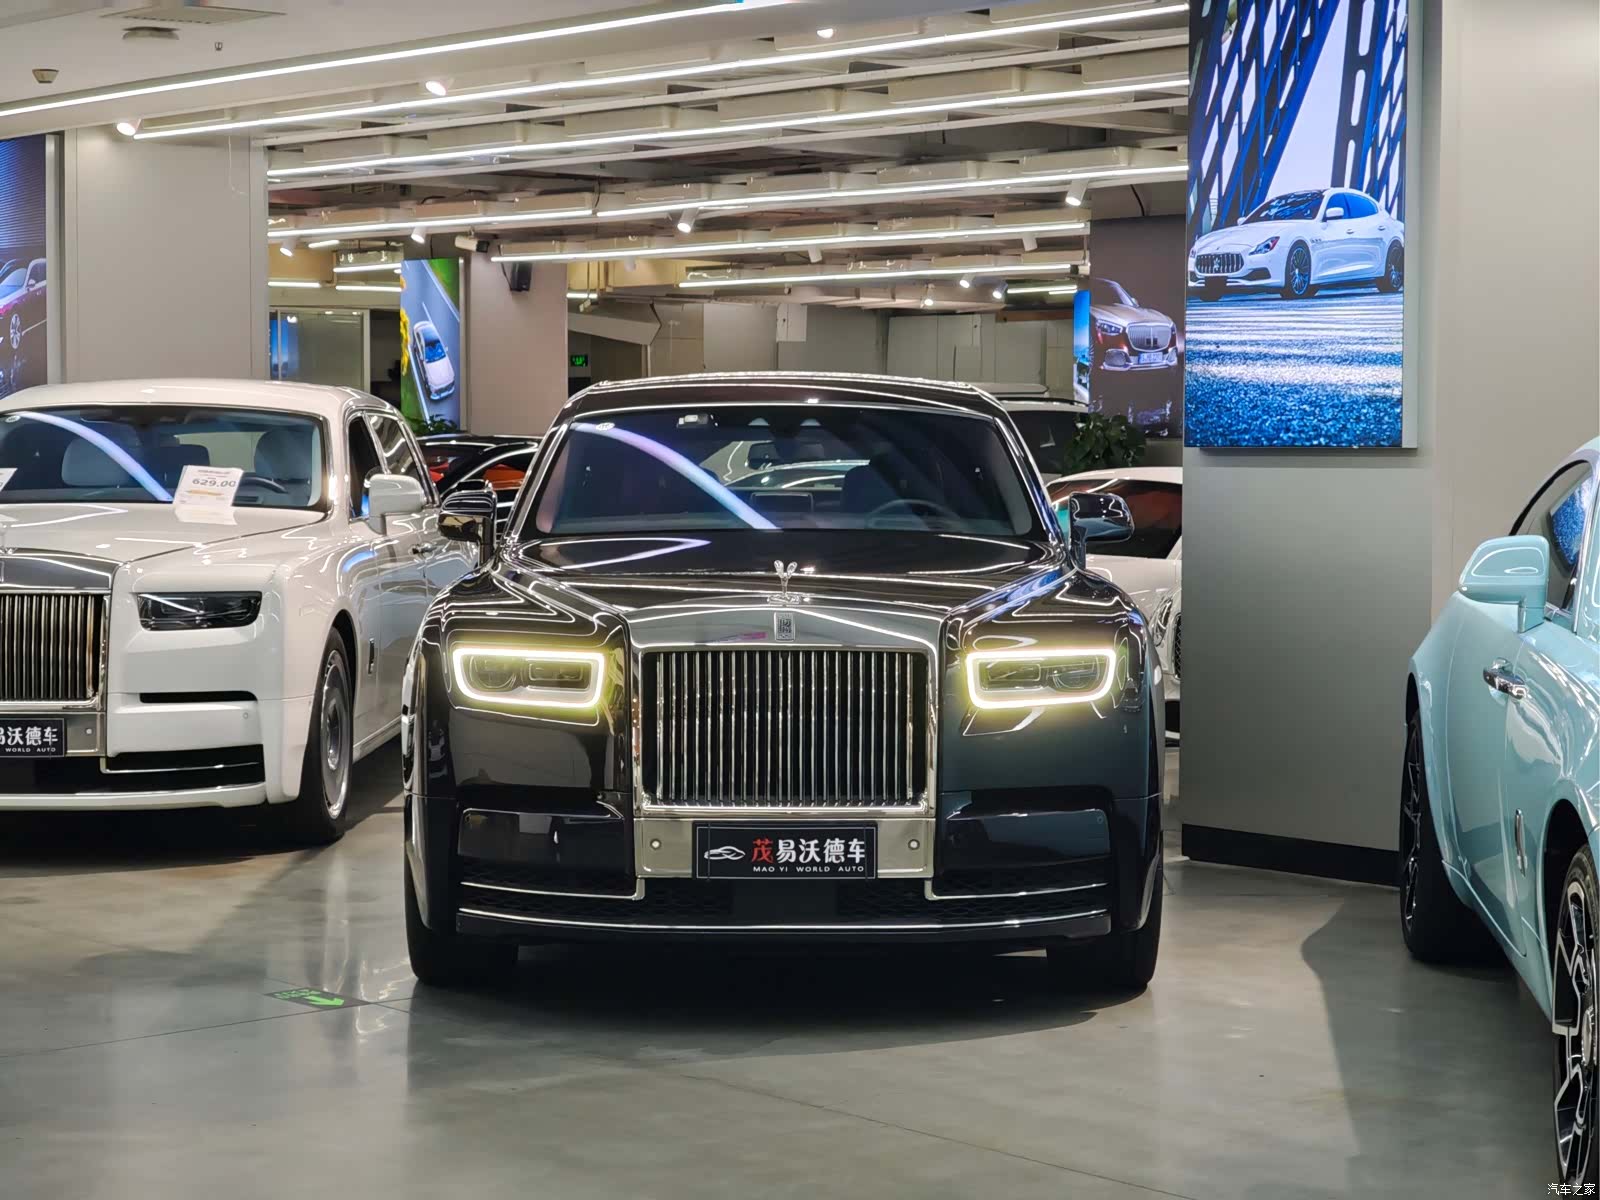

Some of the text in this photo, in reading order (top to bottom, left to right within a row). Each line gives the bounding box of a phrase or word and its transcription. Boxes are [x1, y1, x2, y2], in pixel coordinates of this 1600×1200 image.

[751, 837, 865, 864] 茂易沃德车
